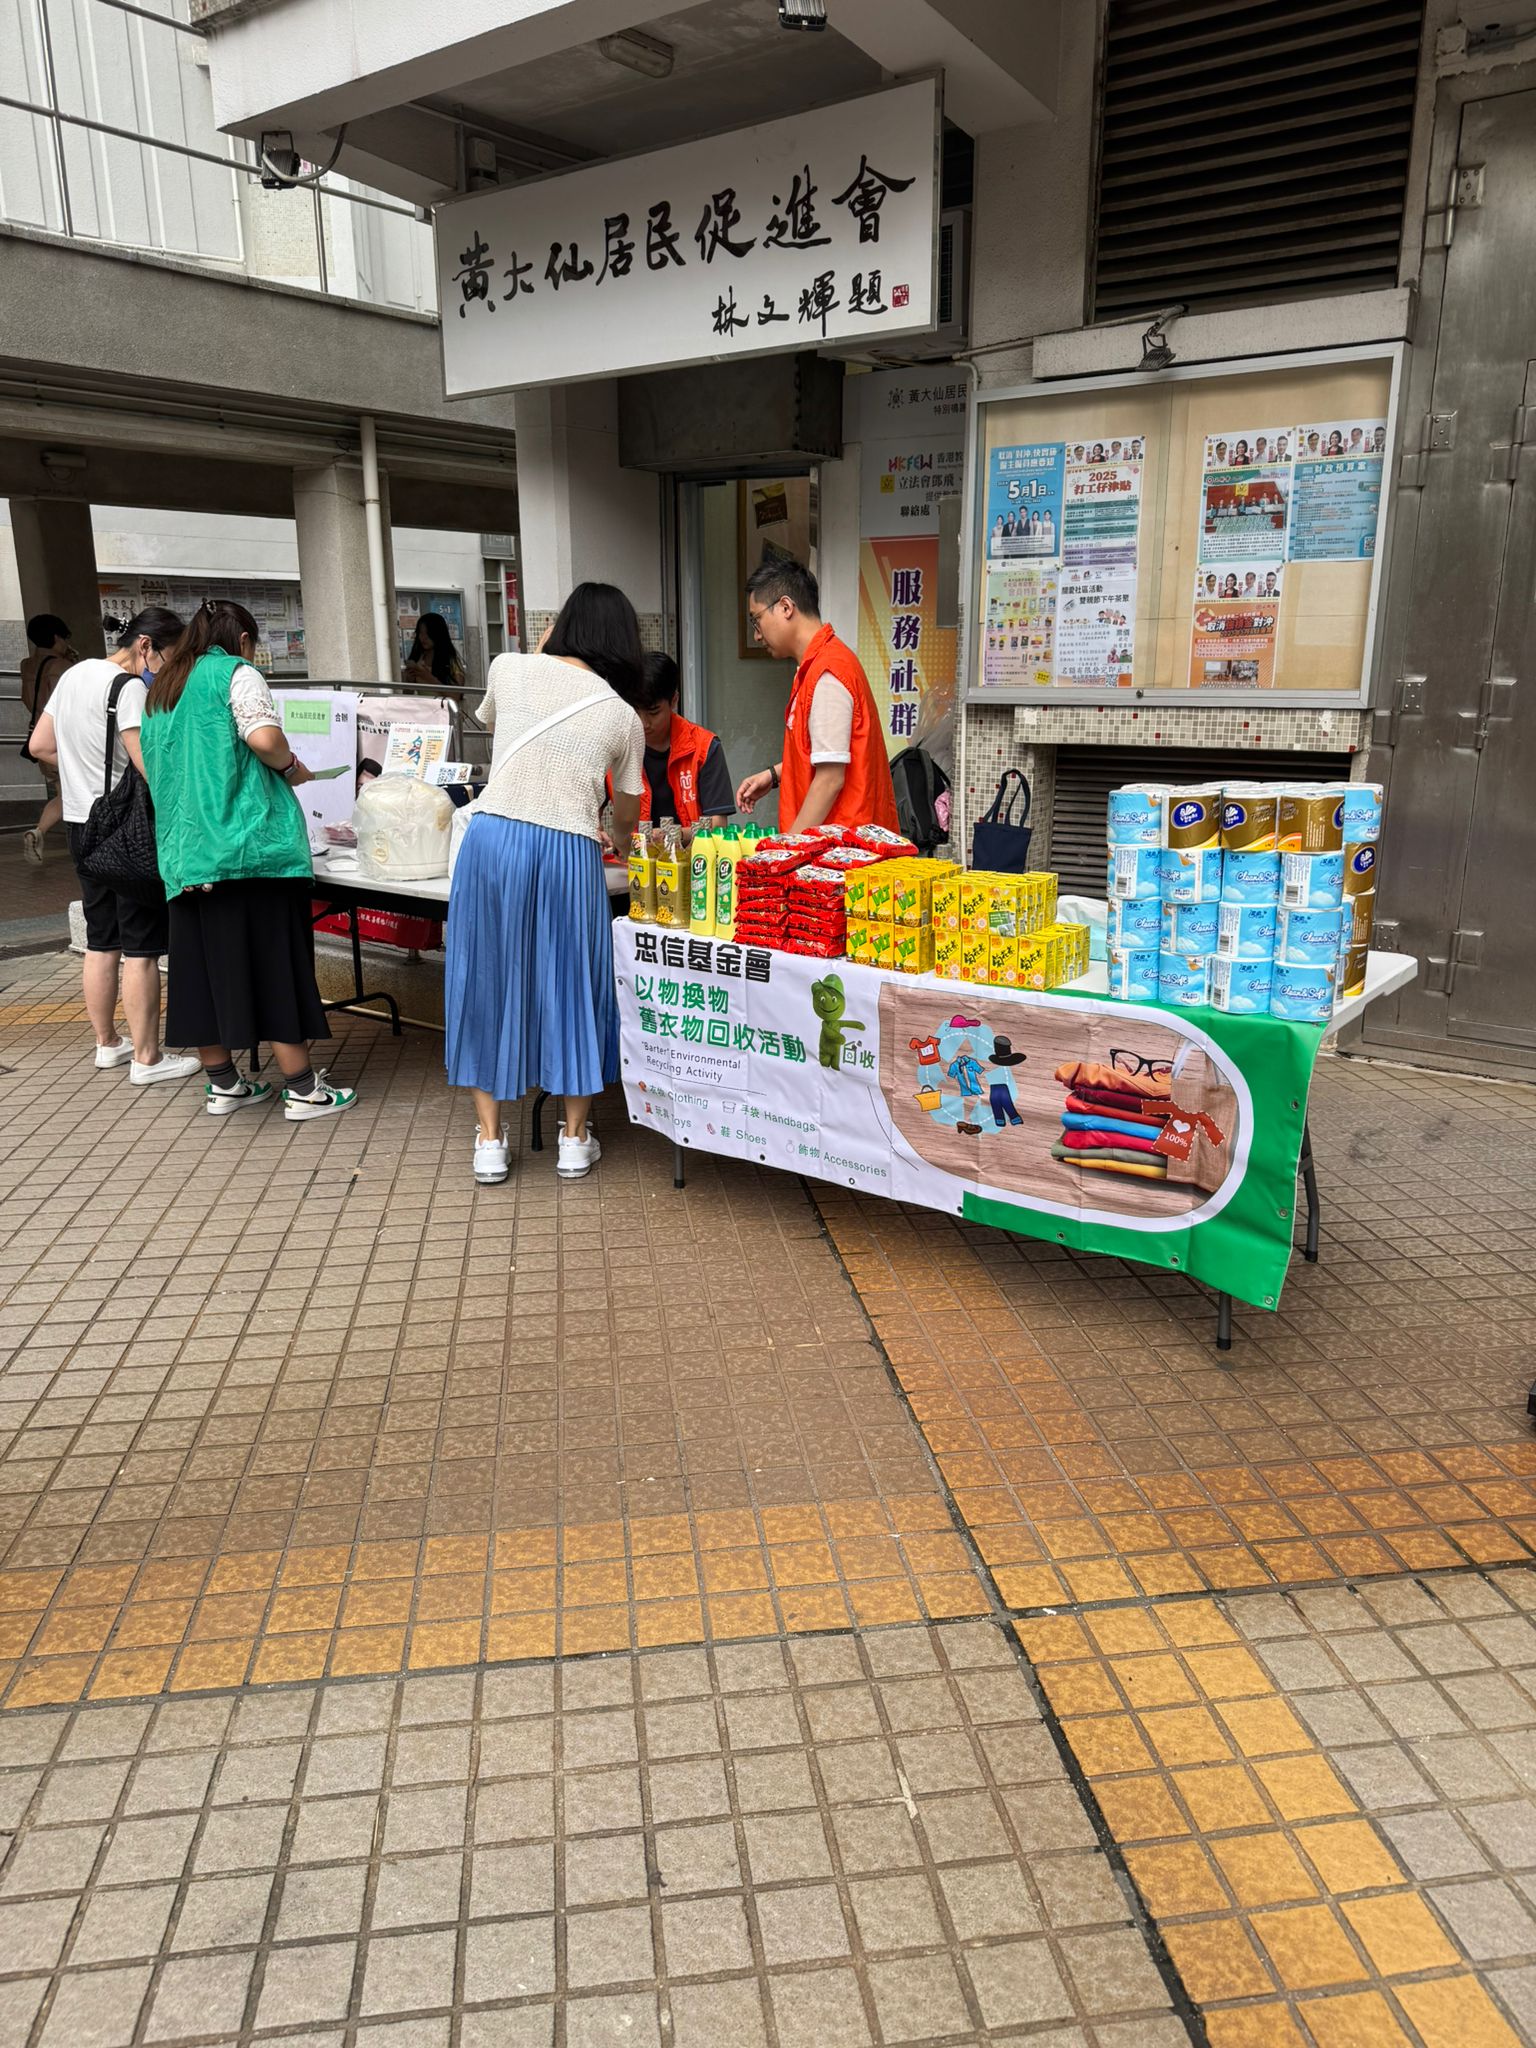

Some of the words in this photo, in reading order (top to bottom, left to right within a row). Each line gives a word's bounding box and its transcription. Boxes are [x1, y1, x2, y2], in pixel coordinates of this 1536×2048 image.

[452, 155, 916, 319] 黃大仙居民促進會
[712, 270, 888, 338] 林文輝題
[888, 453, 932, 472] HKFEW
[1088, 470, 1118, 482] 2025
[1008, 479, 1047, 499] 5月1日
[1073, 480, 1132, 496] 打工仔津貼
[889, 568, 923, 738] 服務社群
[634, 932, 773, 984] 忠信基金會
[634, 974, 730, 1015] 以物換物
[638, 1005, 807, 1064] 舊衣物回收活動
[646, 1055, 682, 1076] Recycling
[686, 1066, 723, 1082] Activity
[670, 1050, 742, 1070] Environmental
[667, 1091, 709, 1110] Clothing
[740, 1104, 760, 1120] 手袋
[764, 1111, 816, 1133] Handbags
[720, 1125, 731, 1139] 鞋
[736, 1129, 767, 1146] Shoes
[1164, 1132, 1188, 1148] 100%
[798, 1143, 820, 1159] 飾物
[823, 1151, 888, 1178] Accessories
